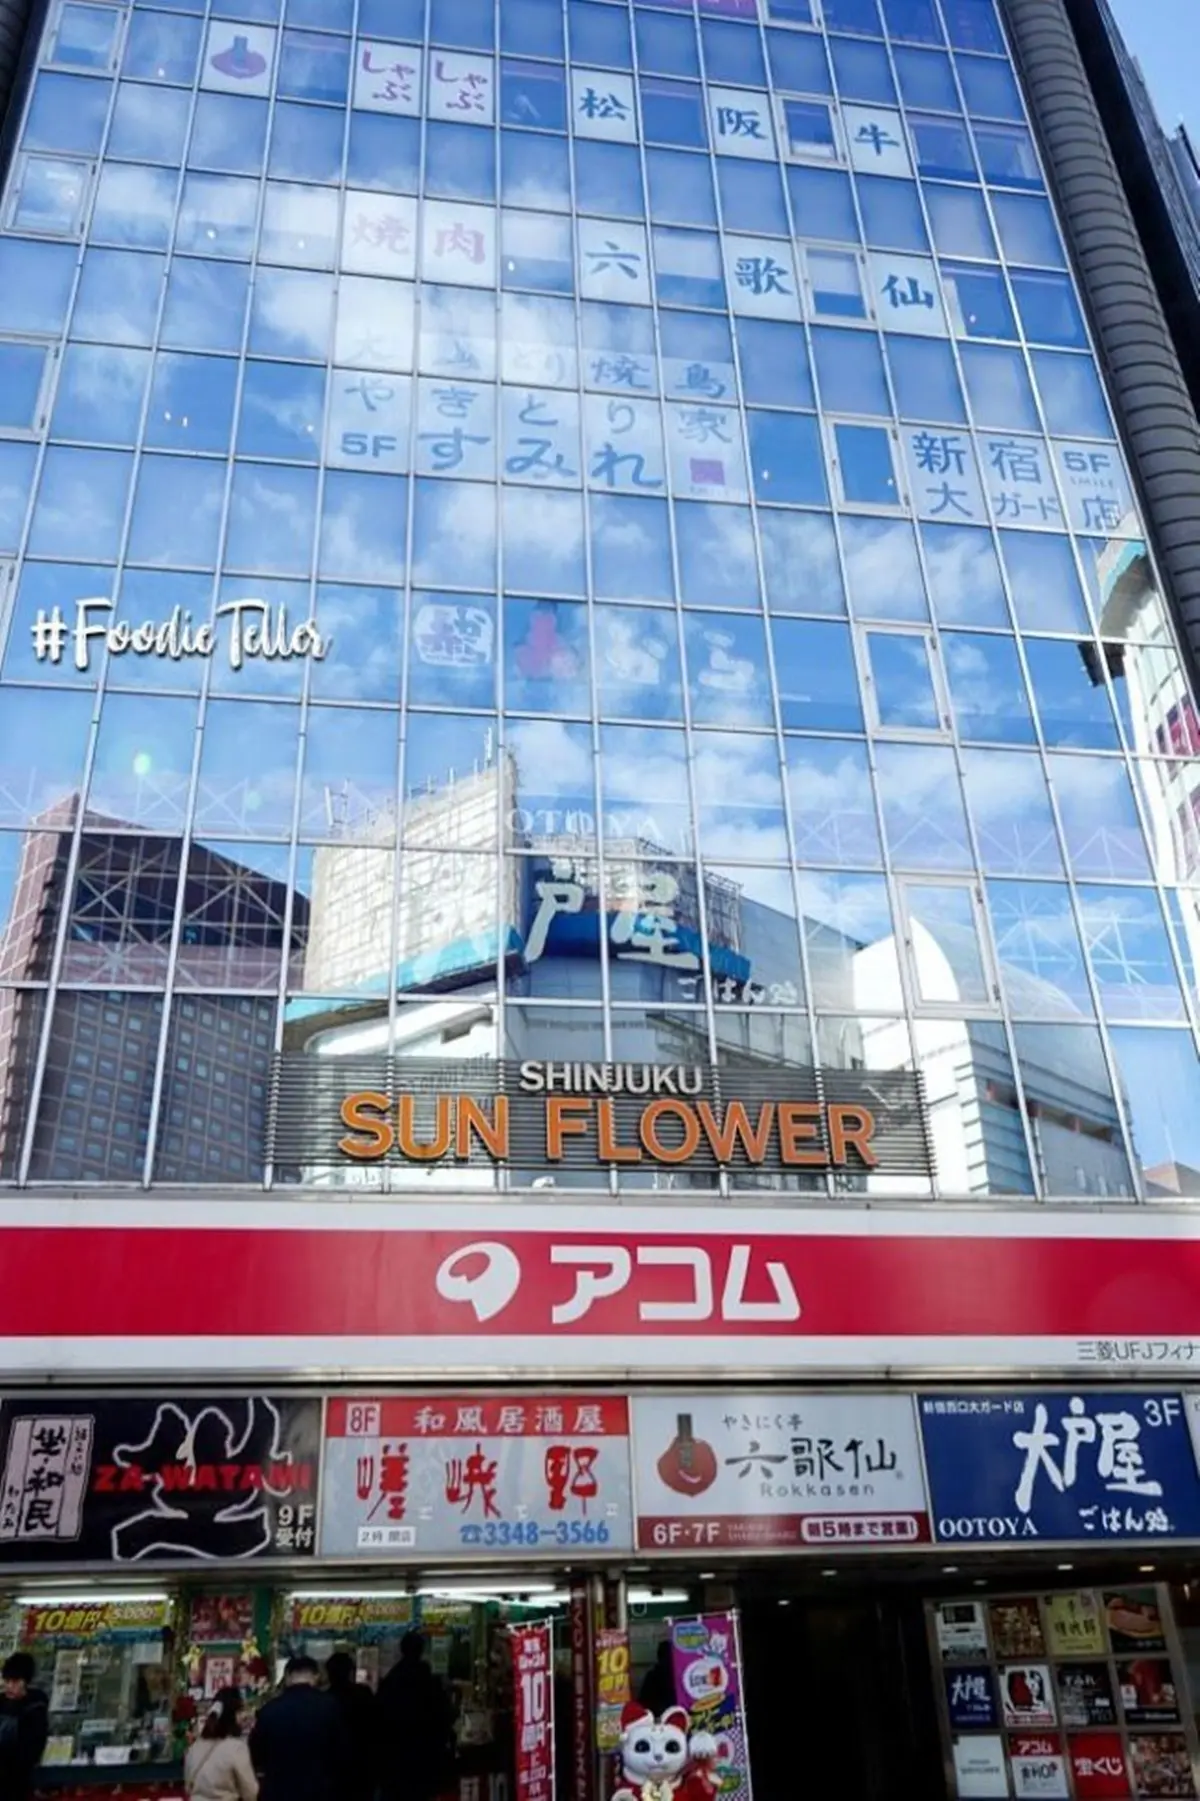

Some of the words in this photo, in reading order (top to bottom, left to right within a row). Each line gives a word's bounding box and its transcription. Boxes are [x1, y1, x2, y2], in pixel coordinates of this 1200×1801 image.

[579, 87, 899, 156] 松阪牛
[352, 213, 486, 265] 焼肉
[585, 243, 935, 310] 六歌仙
[341, 432, 397, 458] 5F
[418, 427, 664, 489] すみれ
[912, 431, 1042, 485] 新宿
[1063, 450, 1111, 474] 5F
[519, 1060, 703, 1095] SHINJUKU
[337, 1091, 509, 1161] SUN
[545, 1098, 880, 1167] FLOWER
[550, 1244, 801, 1325] アコム
[350, 1406, 376, 1433] 8F
[414, 1404, 605, 1434] 和風居酒屋
[1144, 1399, 1181, 1427] 3F
[724, 1438, 899, 1482] 六歌仙
[1013, 1396, 1163, 1514] 大戸屋
[760, 1483, 875, 1498] Rokkasen
[278, 1503, 314, 1525] 9F
[939, 1516, 1039, 1537] OOTOYA
[275, 1528, 315, 1548] 受付
[1074, 1757, 1124, 1777] 宝くじ
